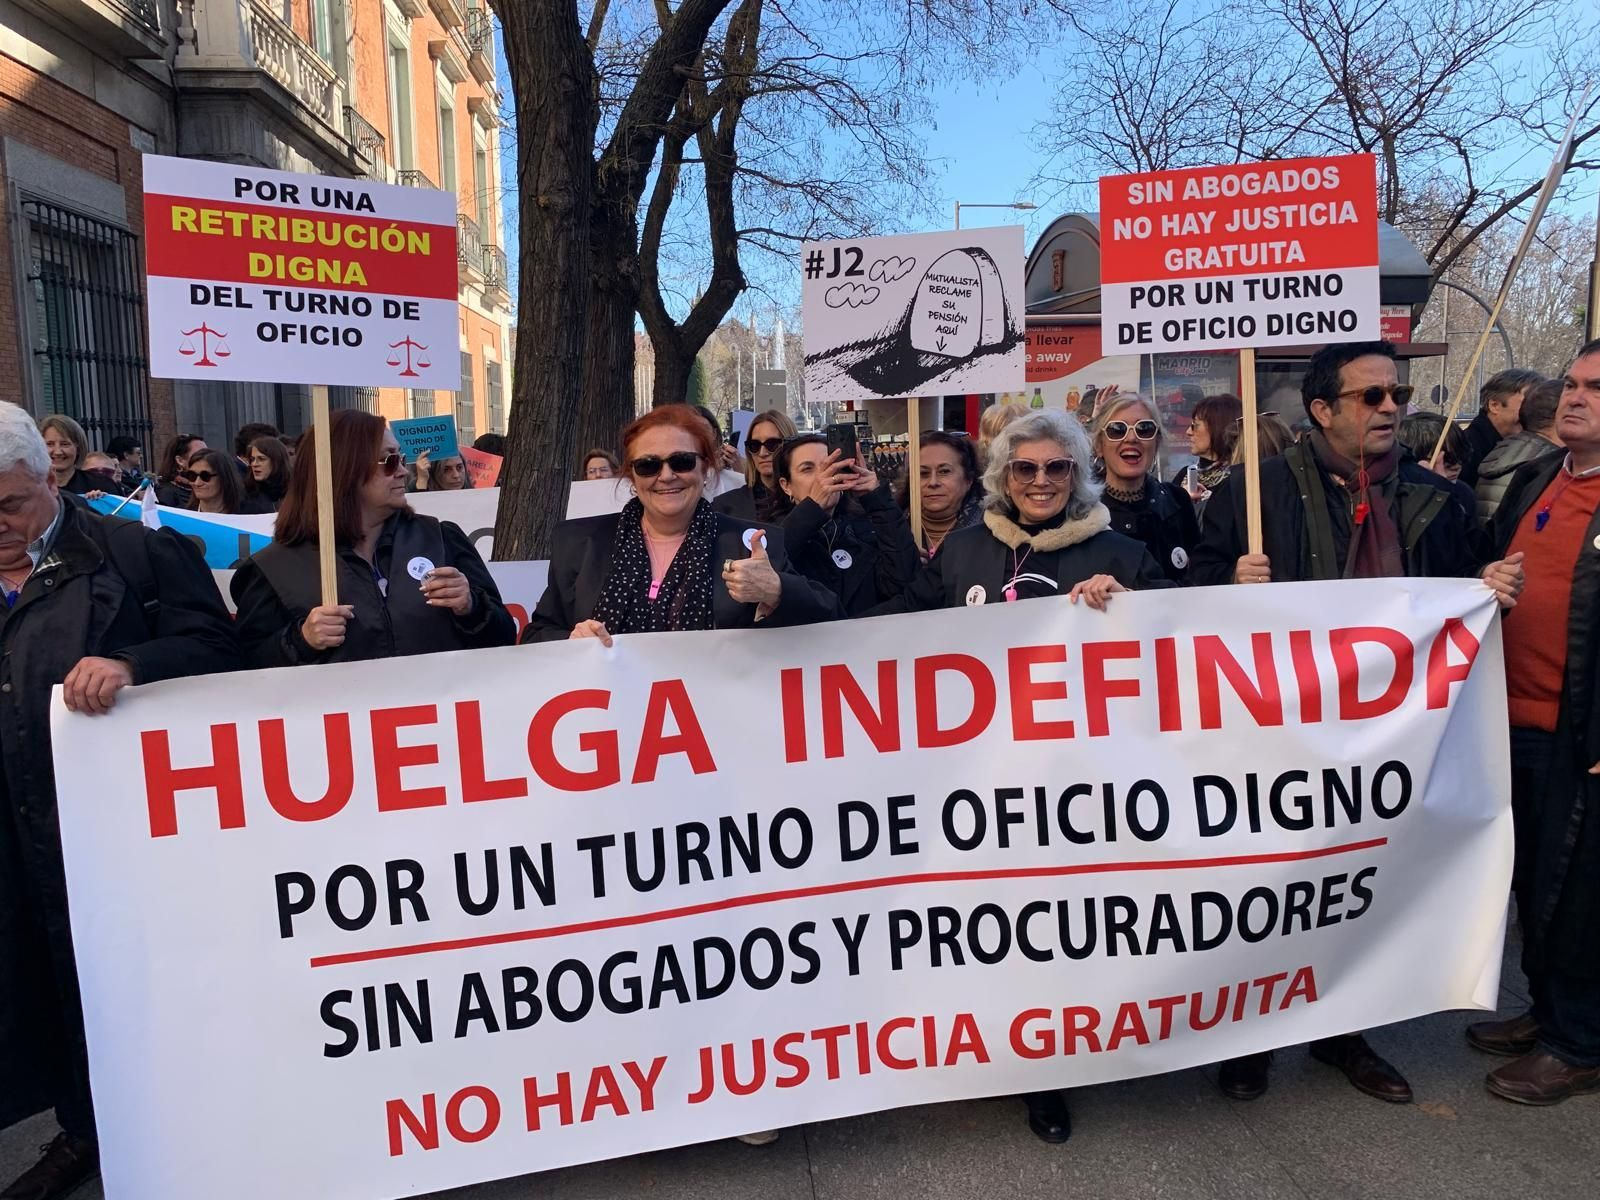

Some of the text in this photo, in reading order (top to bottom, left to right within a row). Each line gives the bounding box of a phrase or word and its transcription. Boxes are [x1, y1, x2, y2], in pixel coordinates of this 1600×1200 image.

[234, 178, 375, 212] POR UNA
[1128, 166, 1339, 205] SIN ABOGADOS
[171, 206, 431, 256] RETRIBUCIÓN
[1113, 201, 1358, 240] NO HAY JUSTICIA
[249, 252, 368, 286] DIGNA
[804, 247, 864, 279] #J2
[1165, 240, 1306, 271] GRATUITA
[925, 272, 979, 287] MUTUALISTA
[928, 285, 972, 298] RECLAME
[1130, 273, 1343, 309] POR UN TURNO
[190, 285, 420, 321] DEL TURNO DE
[928, 311, 968, 324] PENSIÓN
[942, 300, 956, 310] SU
[256, 321, 363, 347] OFICIO
[935, 324, 958, 336] AQUÍ
[1036, 334, 1074, 346] llevar
[1118, 309, 1358, 345] DE OFICIO DIGNO
[1036, 352, 1072, 364] away
[1158, 356, 1211, 370] MADRID
[399, 423, 447, 437] DIGNIDAD
[404, 435, 446, 446] TURNO DE
[141, 617, 1480, 838] HUELGA INDEFINIDA
[275, 759, 1413, 938] POR UN TURNO DE OFICIO DIGNO
[319, 866, 1378, 1058] SIN ABOGADOS Y PROCURADORES
[385, 966, 1318, 1156] NO HAY JUSTICIA GRATUITA
